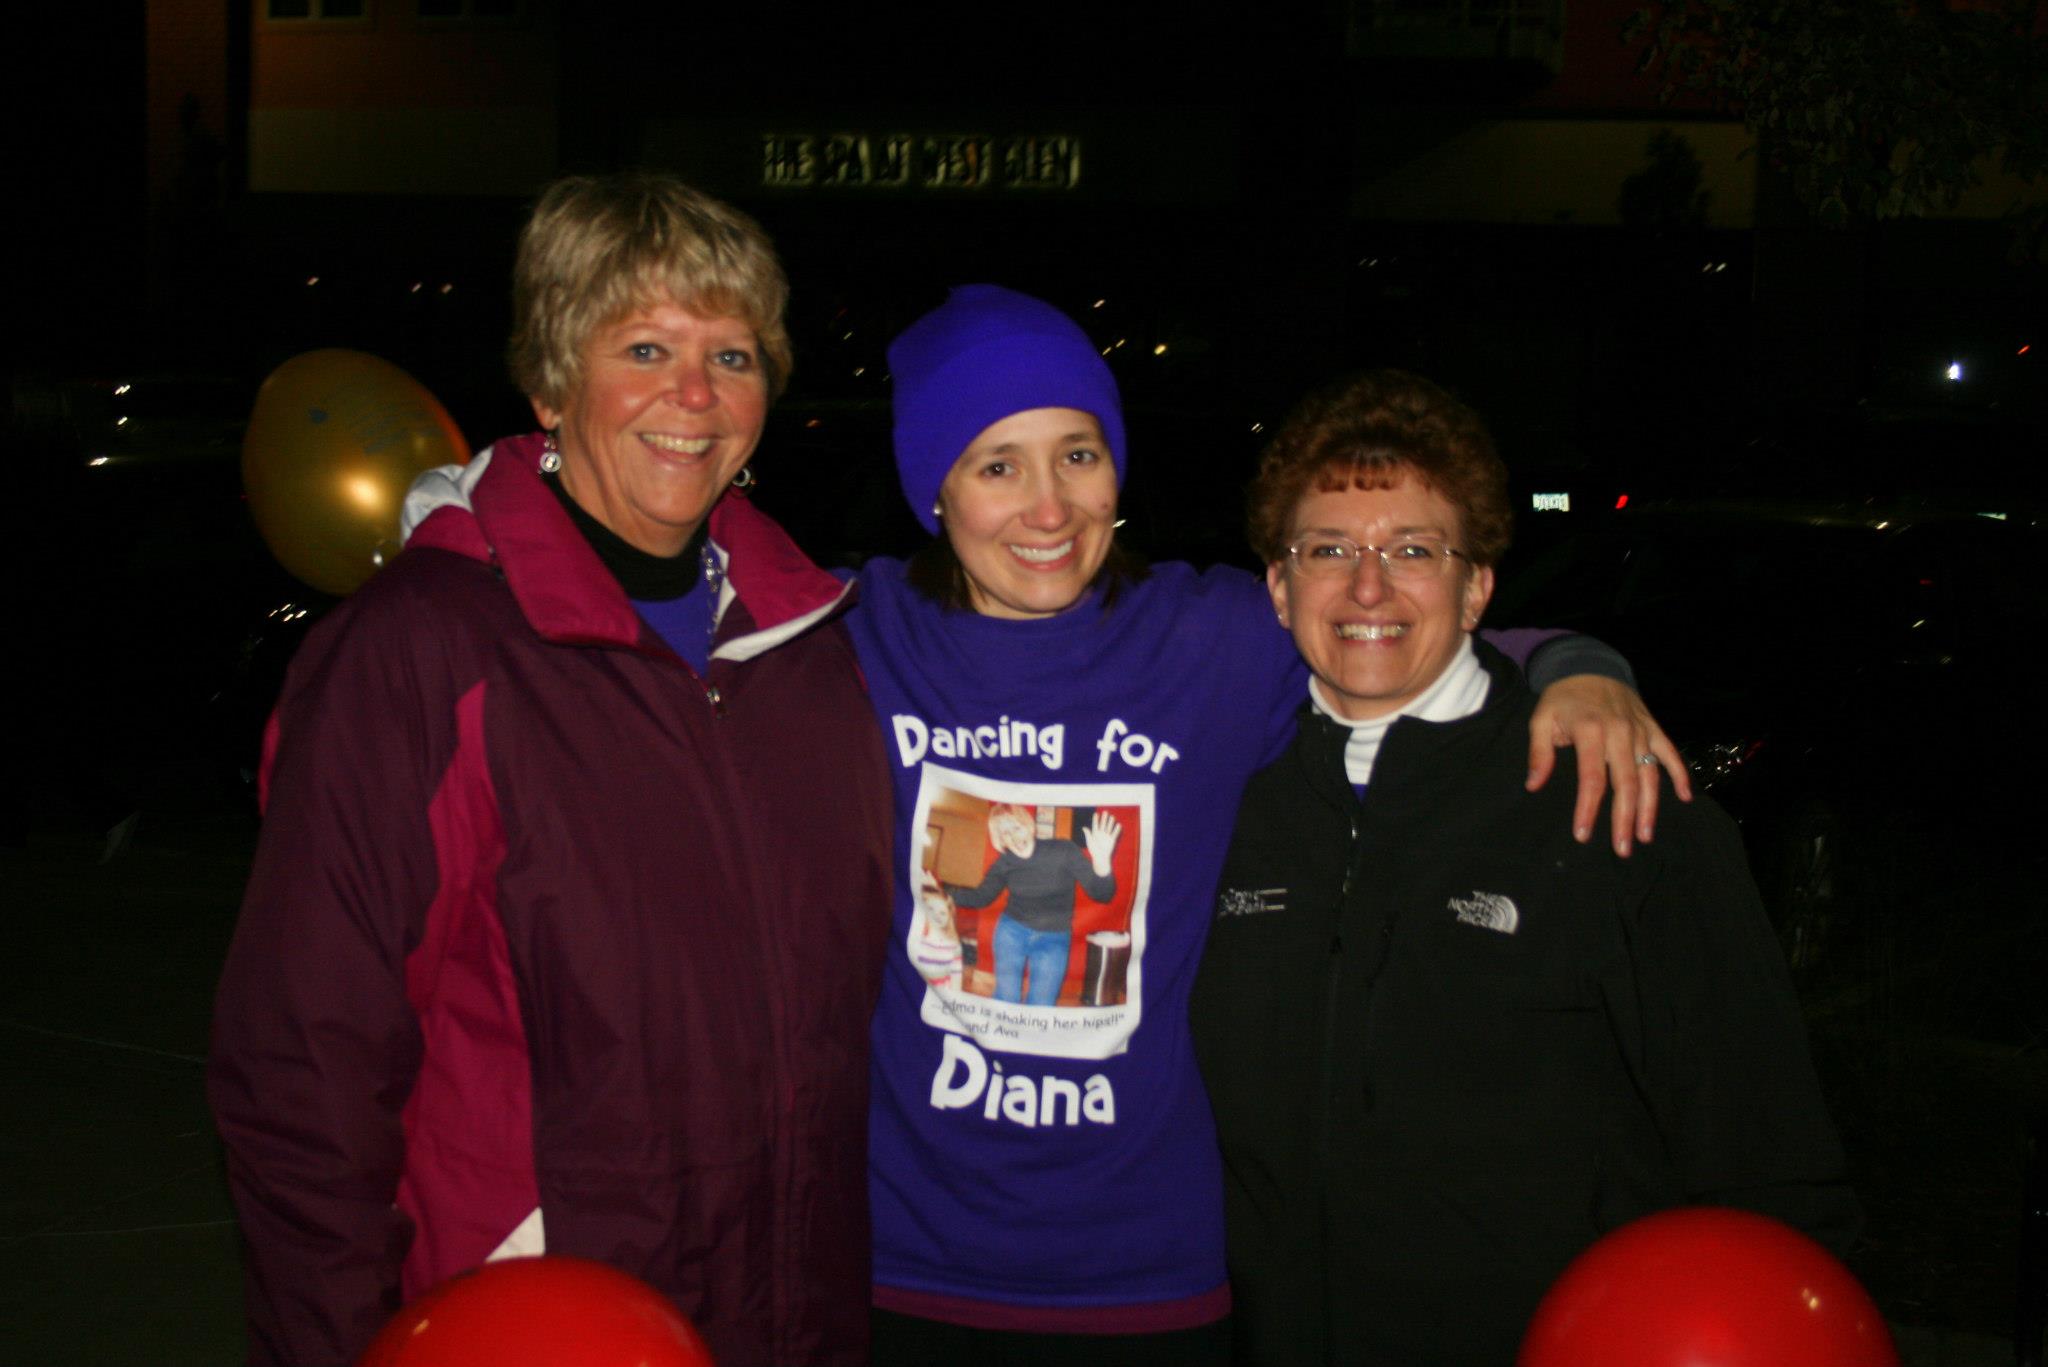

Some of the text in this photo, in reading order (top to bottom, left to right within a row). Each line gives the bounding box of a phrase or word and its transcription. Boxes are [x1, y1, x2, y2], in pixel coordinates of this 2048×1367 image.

[892, 713, 1179, 774] Dancing for
[980, 1007, 992, 1017] is
[996, 1010, 1048, 1031] shaking
[1053, 1015, 1078, 1030] her
[930, 1033, 1115, 1128] Diana
